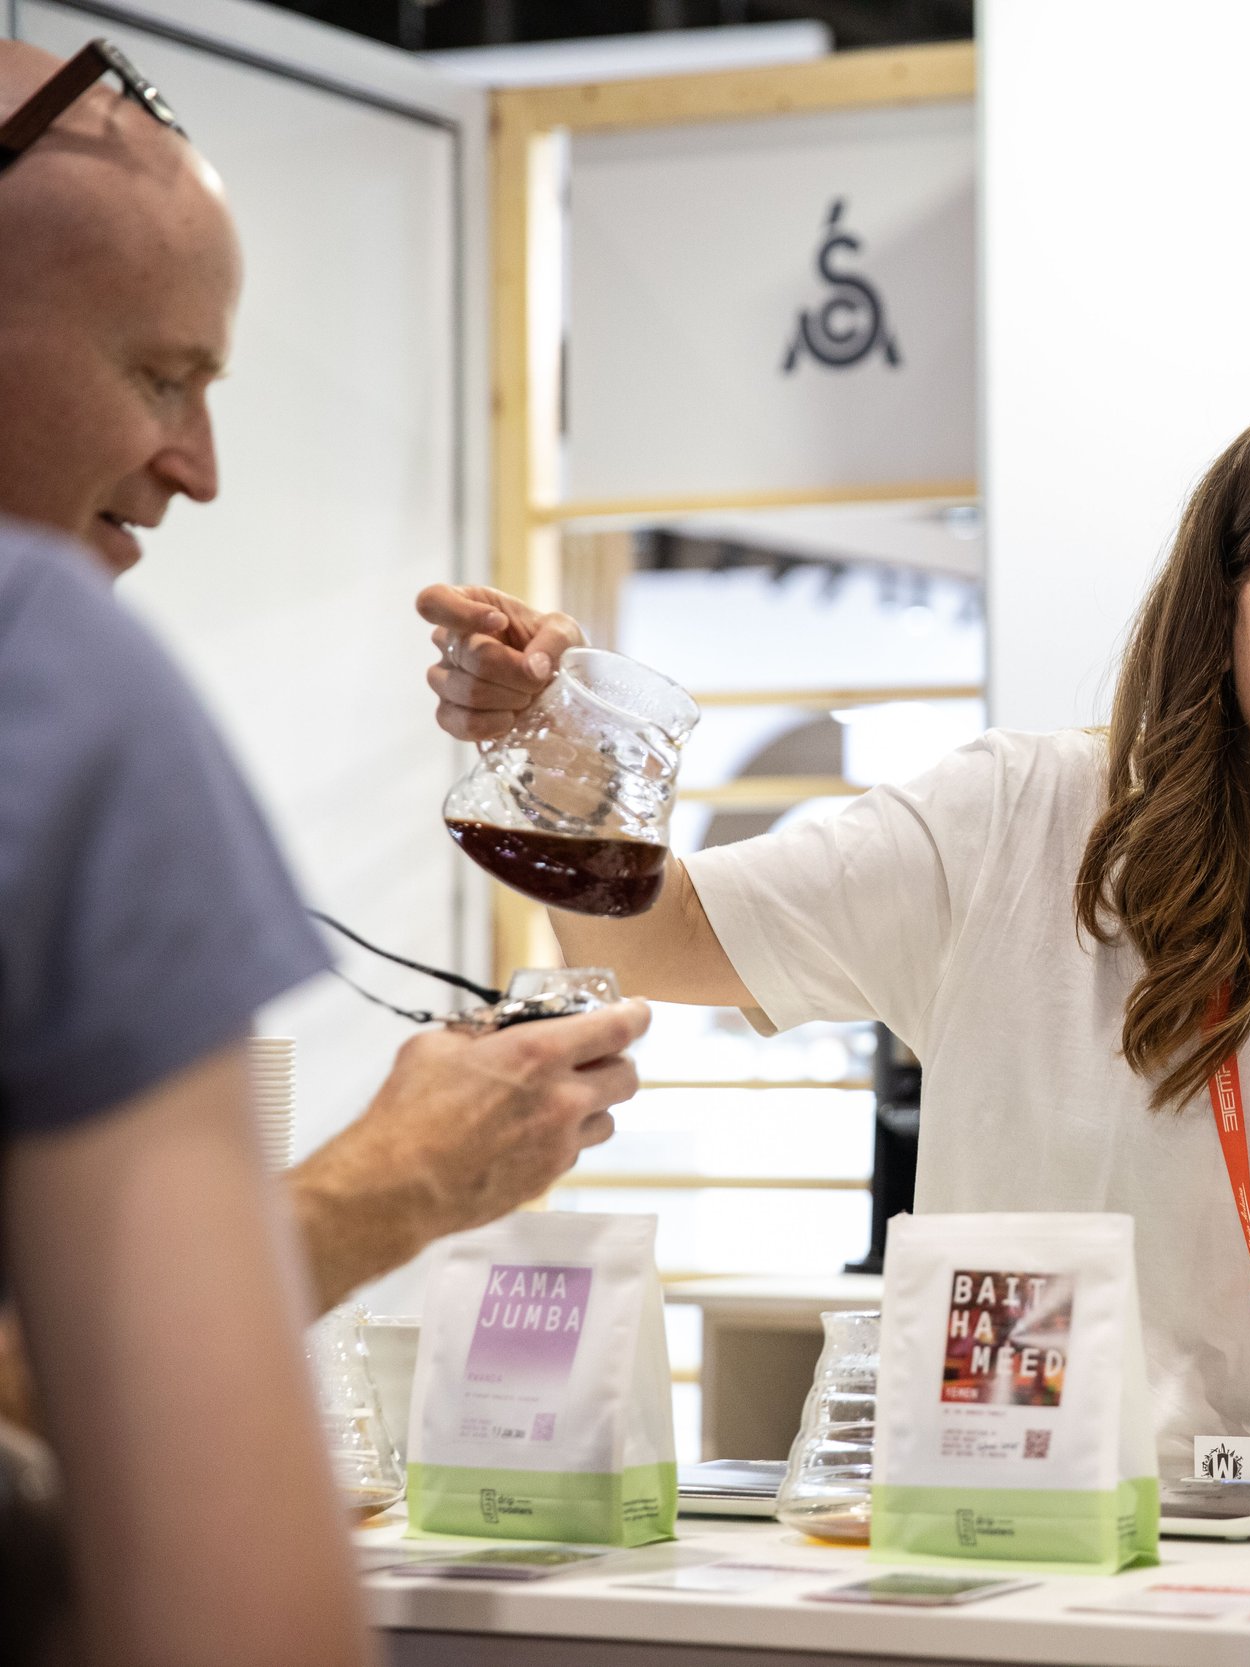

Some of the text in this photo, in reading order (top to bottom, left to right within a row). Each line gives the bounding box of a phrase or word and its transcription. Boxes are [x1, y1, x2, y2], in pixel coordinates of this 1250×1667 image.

[488, 1270, 567, 1299] KAMA
[953, 1275, 1047, 1307] BAIT
[480, 1302, 581, 1333] JUMBA
[950, 1309, 995, 1340] HA
[969, 1345, 1065, 1379] MEED
